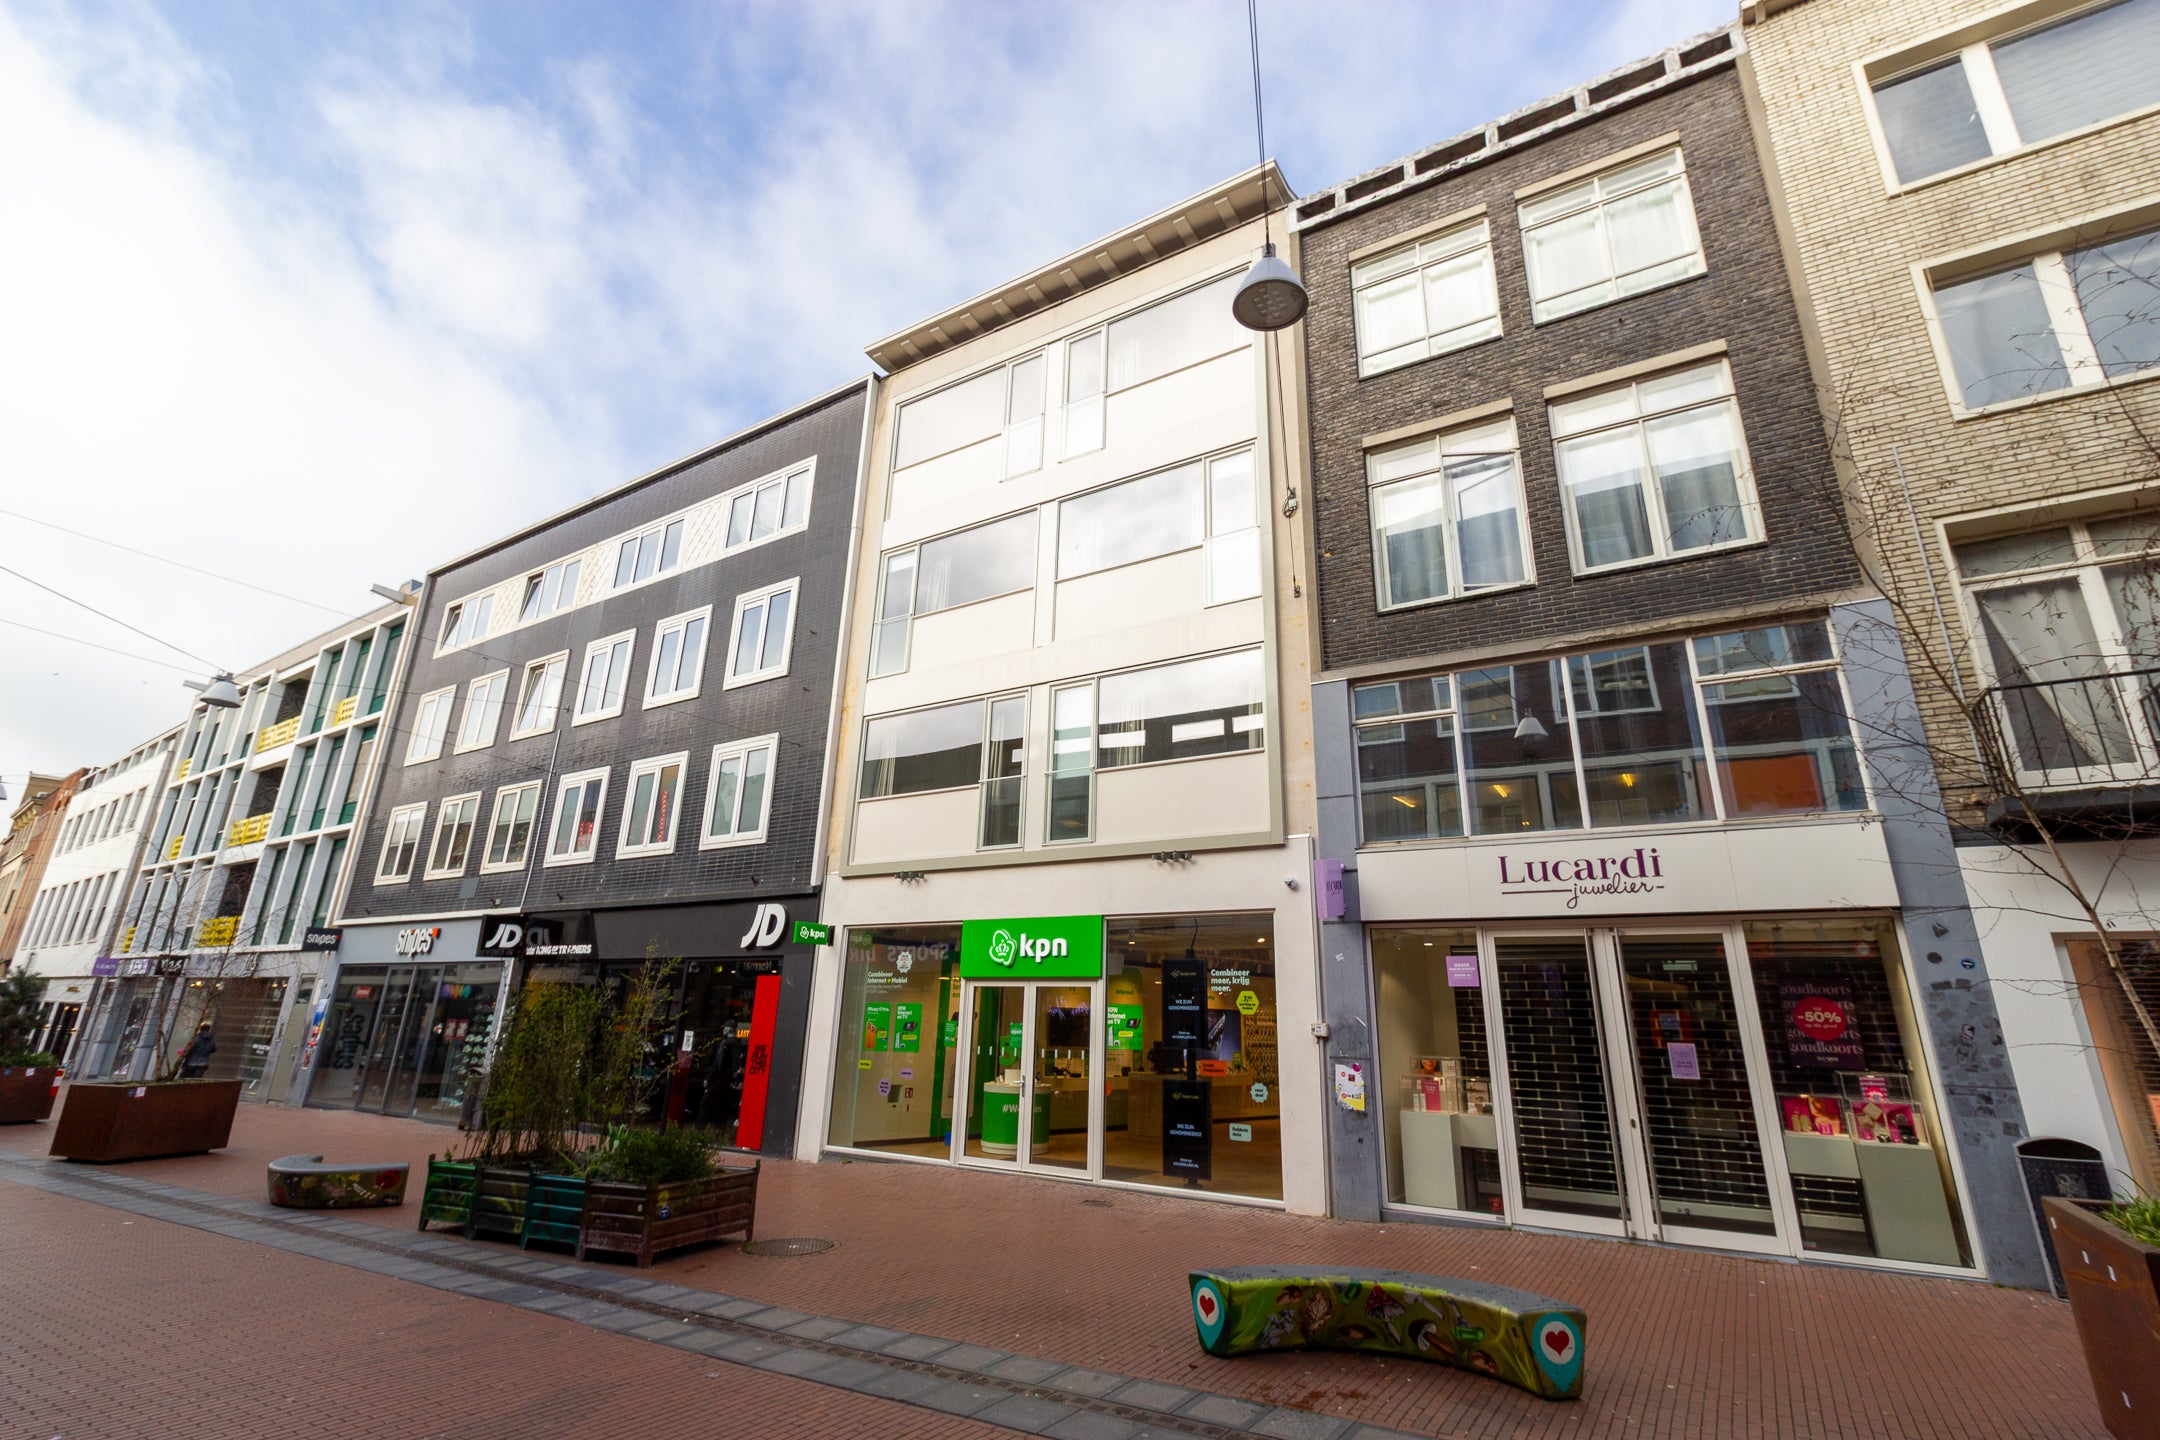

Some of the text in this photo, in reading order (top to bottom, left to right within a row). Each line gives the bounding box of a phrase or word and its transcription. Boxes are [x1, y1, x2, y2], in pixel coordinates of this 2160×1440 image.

[1498, 848, 1664, 884] Lucardi
[1566, 872, 1655, 909] juwelier
[485, 924, 522, 948] JD
[740, 903, 786, 949] JD
[810, 929, 825, 940] kpn
[306, 933, 336, 945] snipes
[396, 928, 432, 958] snipes
[1020, 933, 1067, 963] kpn
[1232, 977, 1249, 985] krijg
[1797, 1011, 1842, 1023] -50%
[1790, 1041, 1864, 1055] goudkoorts
